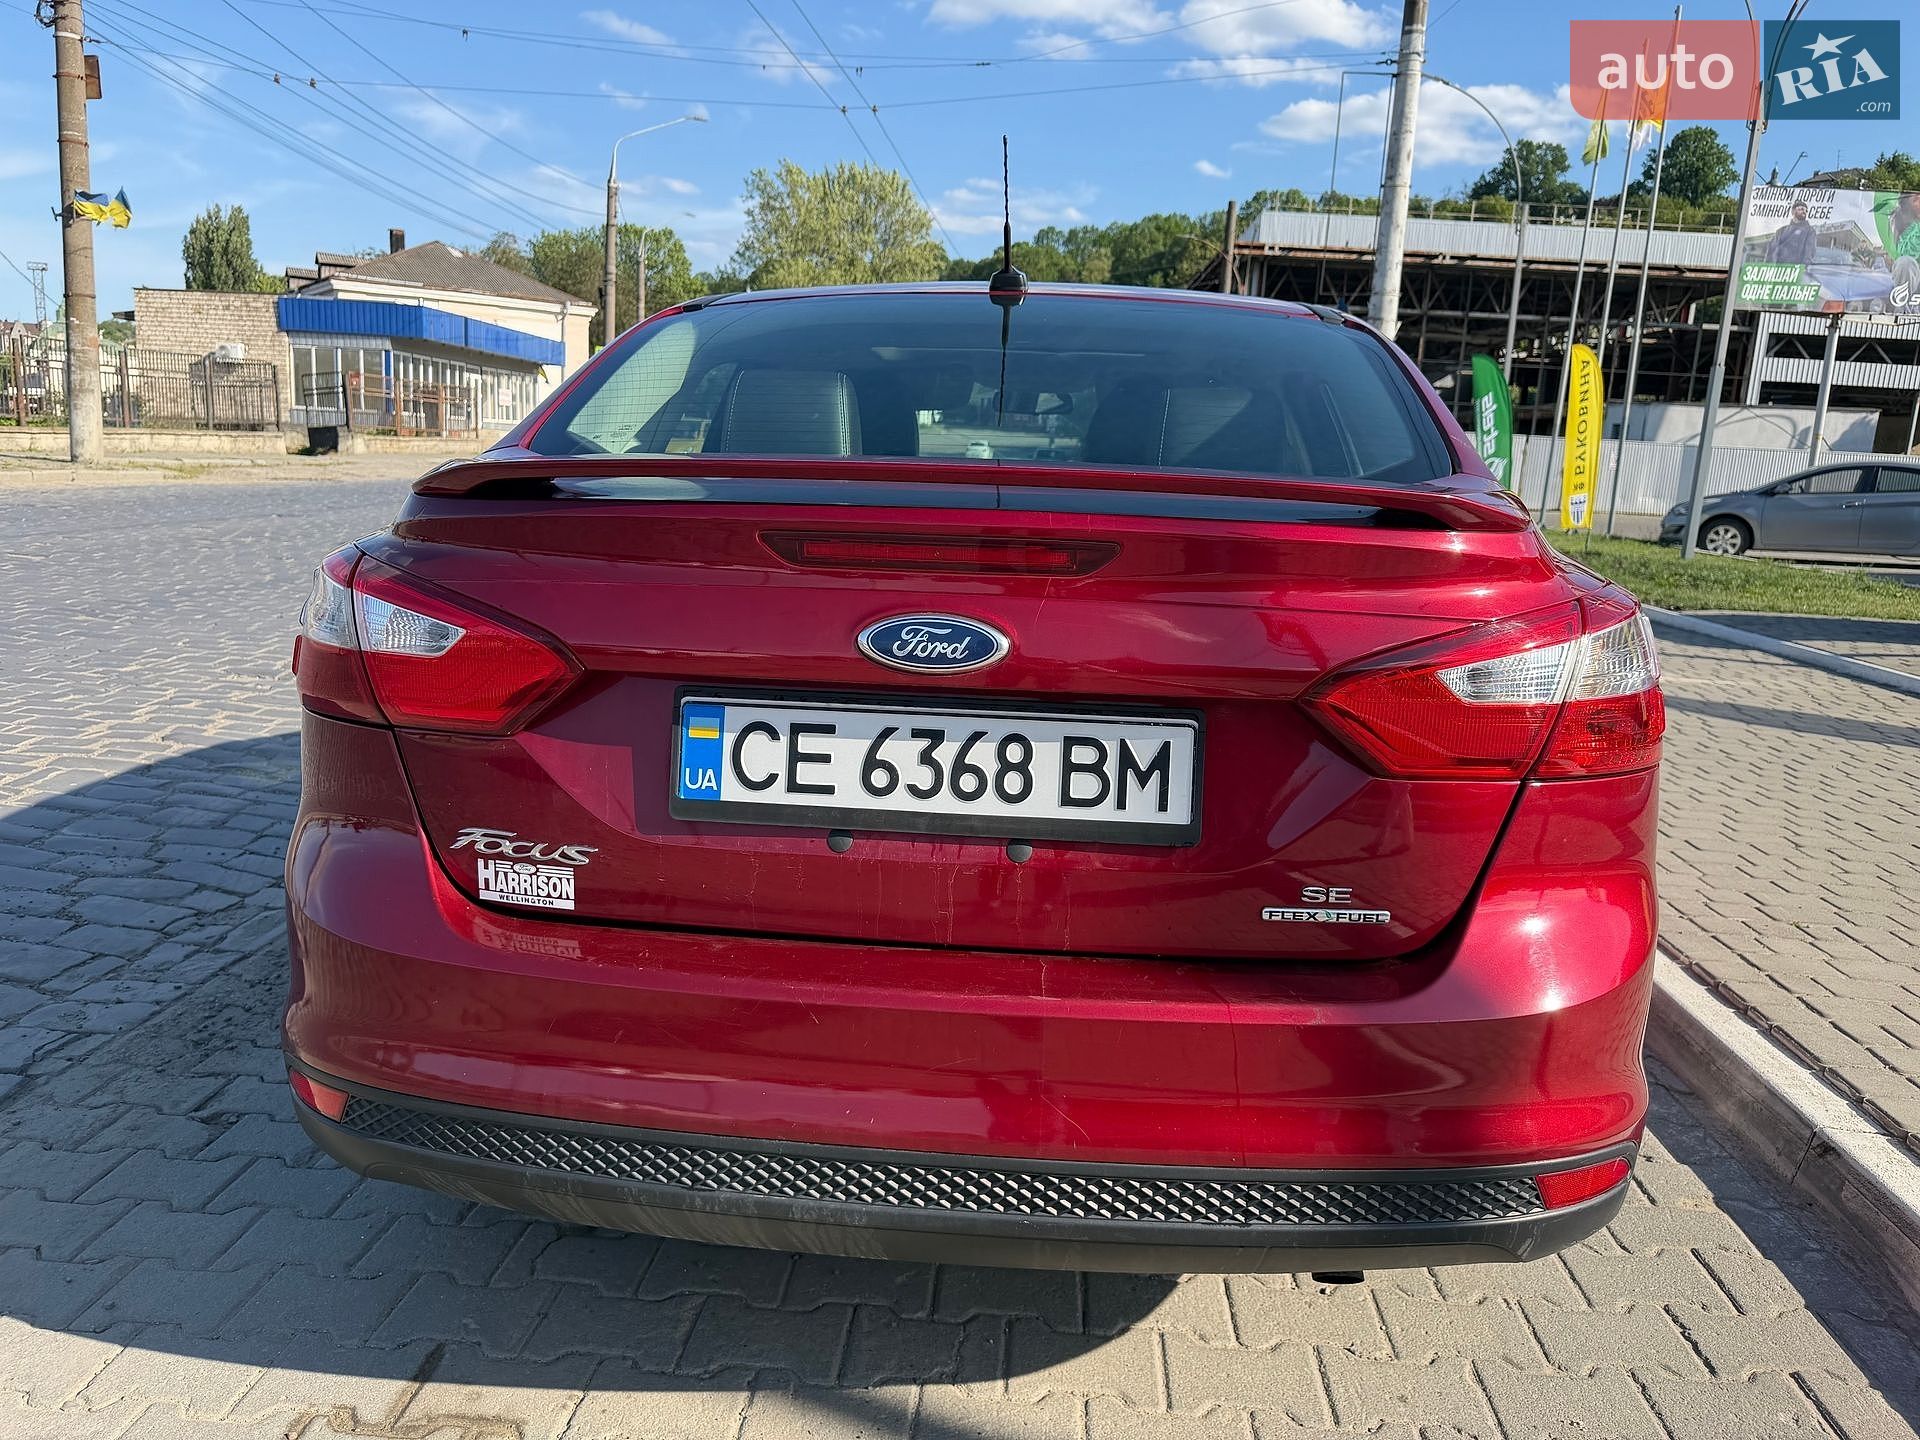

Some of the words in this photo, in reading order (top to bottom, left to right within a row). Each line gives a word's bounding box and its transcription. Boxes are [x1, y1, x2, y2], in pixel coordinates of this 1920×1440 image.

[1750, 202, 1792, 218] ЗМІНЮЙ
[1808, 206, 1833, 219] СЕБЕ
[1743, 264, 1801, 283] ЗАЛИШАЙ
[1741, 284, 1773, 300] ОДНЕ
[1772, 285, 1819, 301] ПАЛЬНЕ
[892, 625, 972, 661] Ford
[731, 720, 837, 795] CE
[861, 727, 1034, 804] 6368
[1061, 736, 1172, 813] BM
[685, 767, 718, 792] UA
[498, 893, 554, 907] WELLINGTON
[1301, 886, 1353, 903] SE
[1267, 910, 1319, 921] FLEX
[1335, 912, 1387, 923] FUEL
